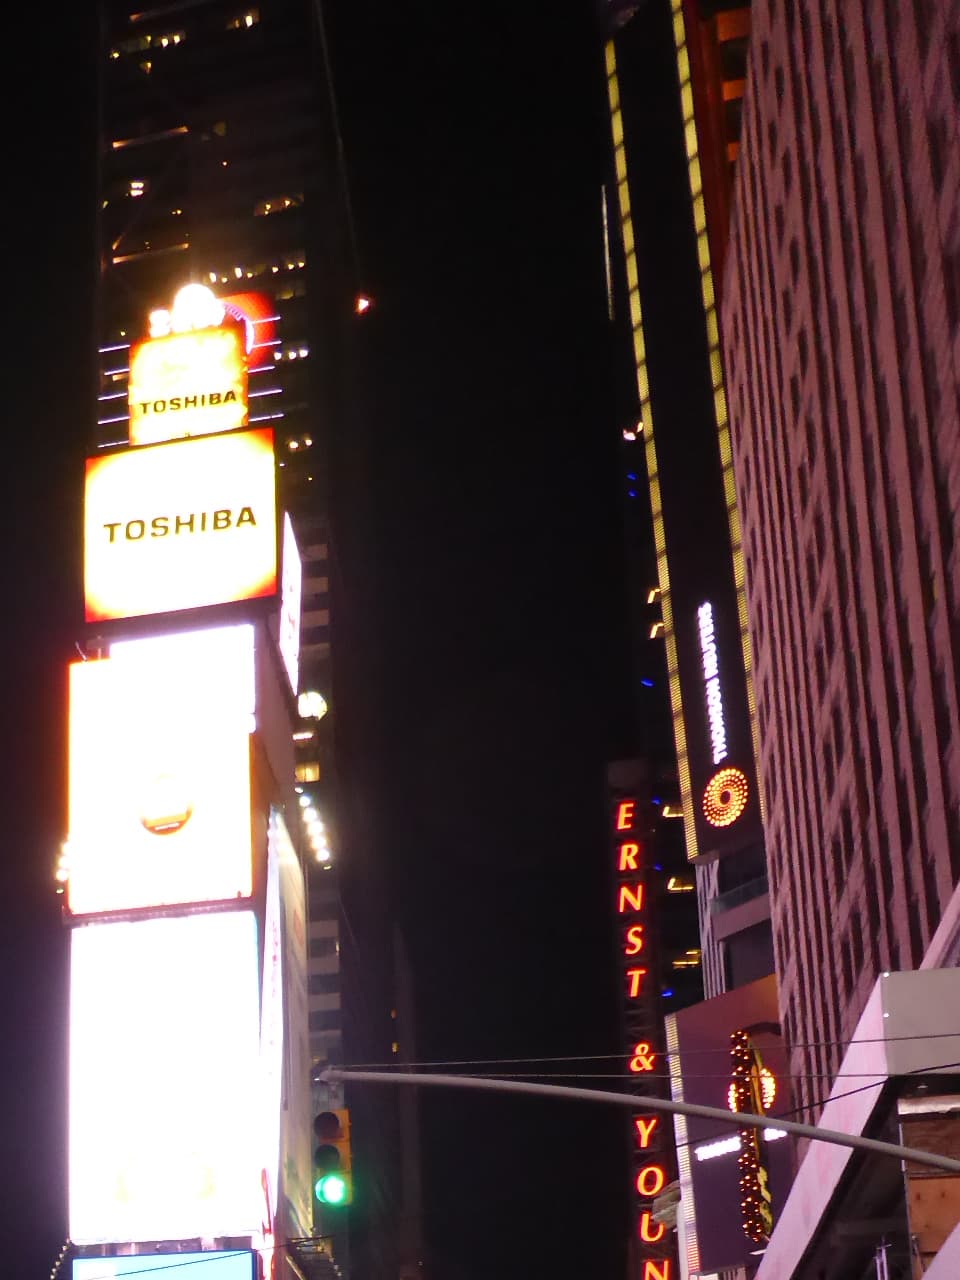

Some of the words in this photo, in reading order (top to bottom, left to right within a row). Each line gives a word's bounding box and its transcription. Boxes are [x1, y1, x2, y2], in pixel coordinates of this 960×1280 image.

[139, 389, 238, 415] TOSHIBA
[103, 506, 257, 543] TOSHIBA
[617, 803, 647, 998] ERNST
[630, 1044, 655, 1072] &
